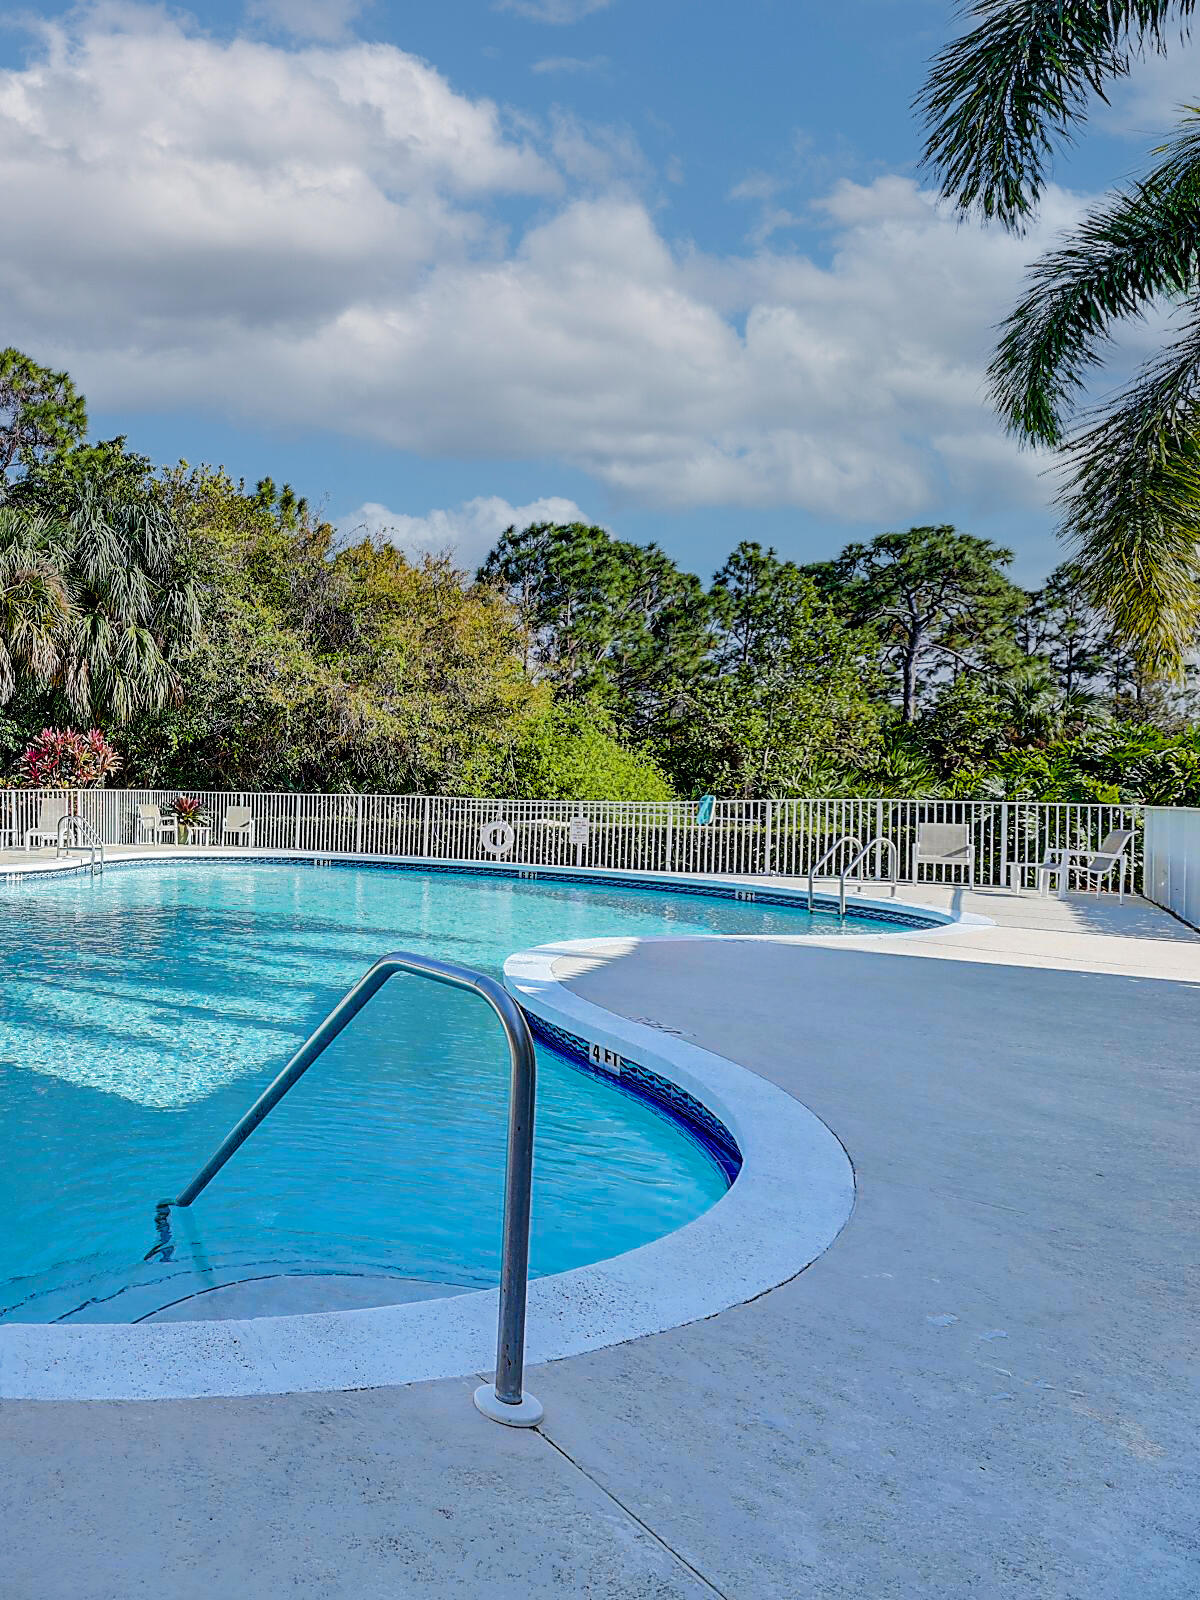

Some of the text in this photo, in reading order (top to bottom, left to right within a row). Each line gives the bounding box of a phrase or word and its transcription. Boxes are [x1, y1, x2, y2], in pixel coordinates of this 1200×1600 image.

[323, 859, 331, 867] FT
[528, 871, 537, 880] FT
[745, 892, 753, 902] FT
[592, 1044, 619, 1067] 4 FT
